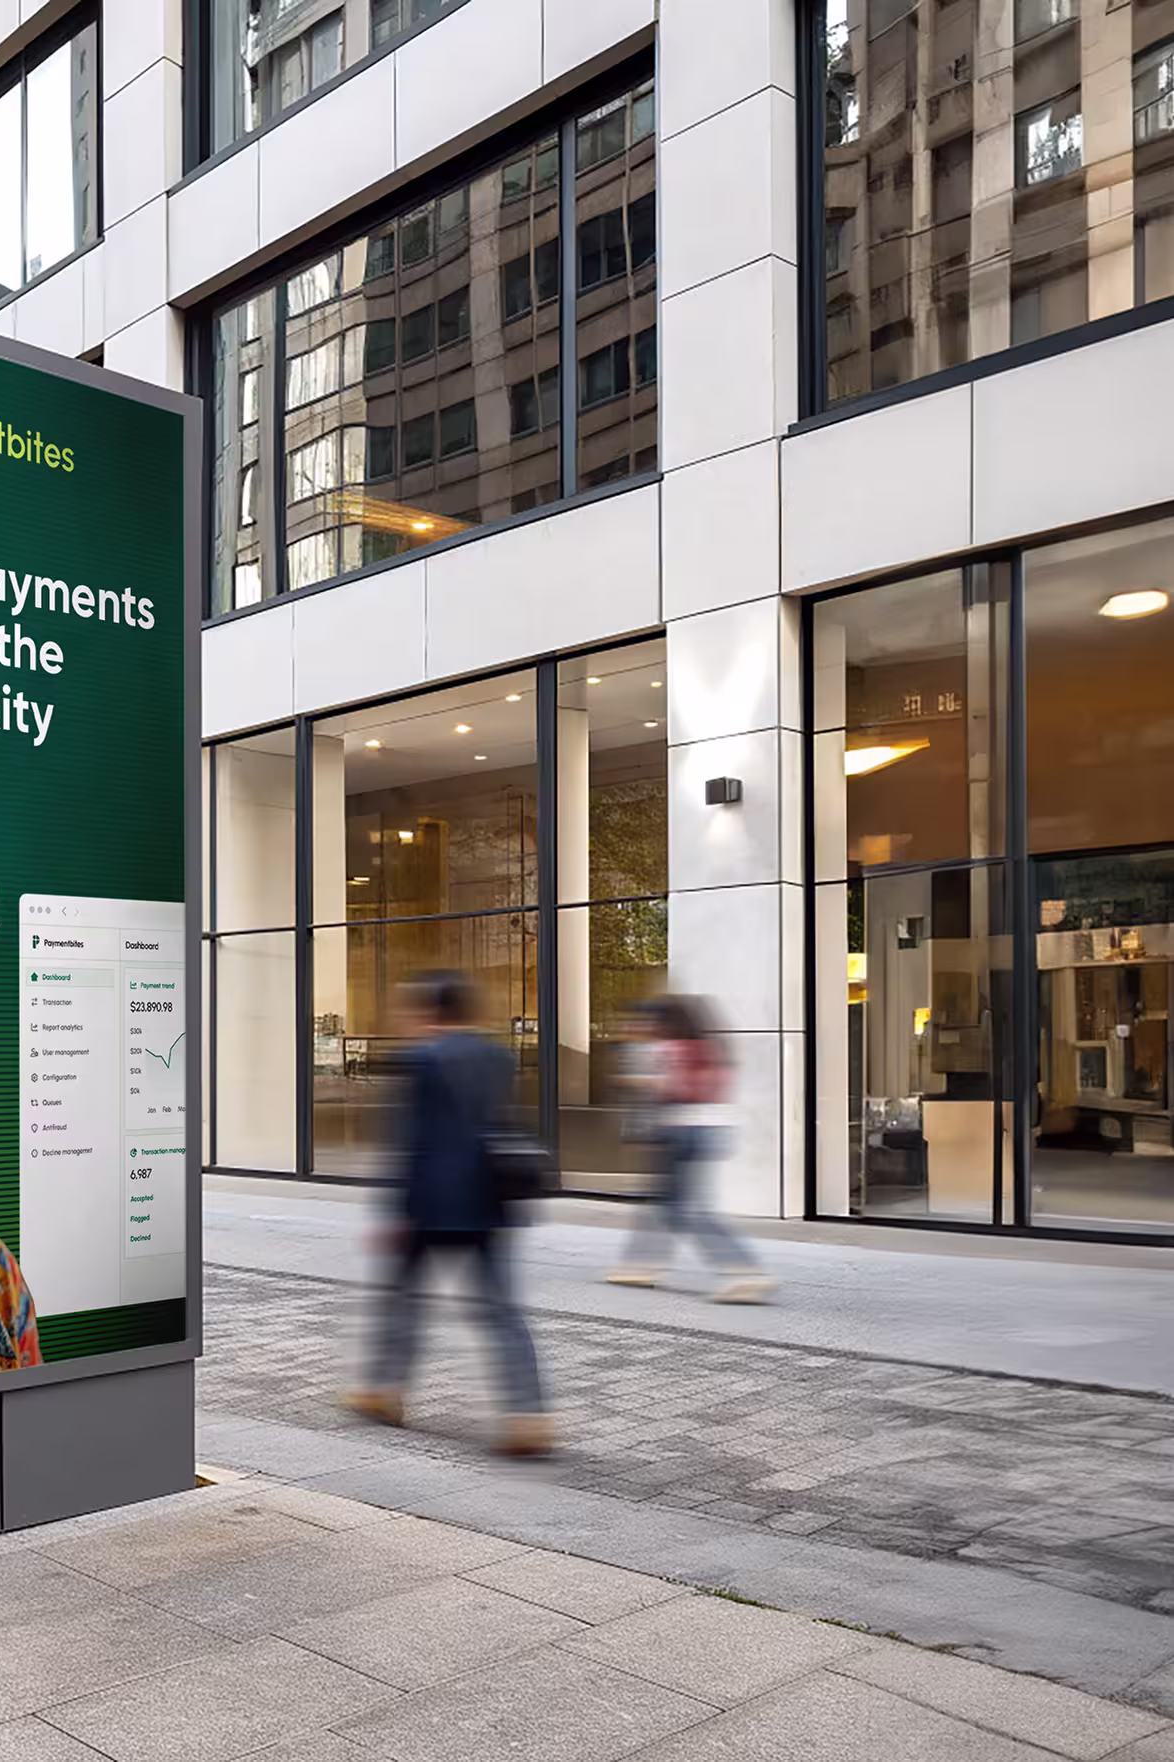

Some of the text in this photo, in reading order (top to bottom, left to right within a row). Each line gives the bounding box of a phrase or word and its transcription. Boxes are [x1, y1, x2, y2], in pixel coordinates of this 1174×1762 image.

[43, 939, 84, 949] Paymentbites
[125, 941, 159, 950] Dashboard
[42, 973, 71, 981] Dashboard
[42, 998, 72, 1006] Transaction
[42, 1024, 83, 1032] Report analytics
[42, 1048, 89, 1057] User management
[42, 1074, 77, 1082] Configuration
[42, 1099, 62, 1107] Queues
